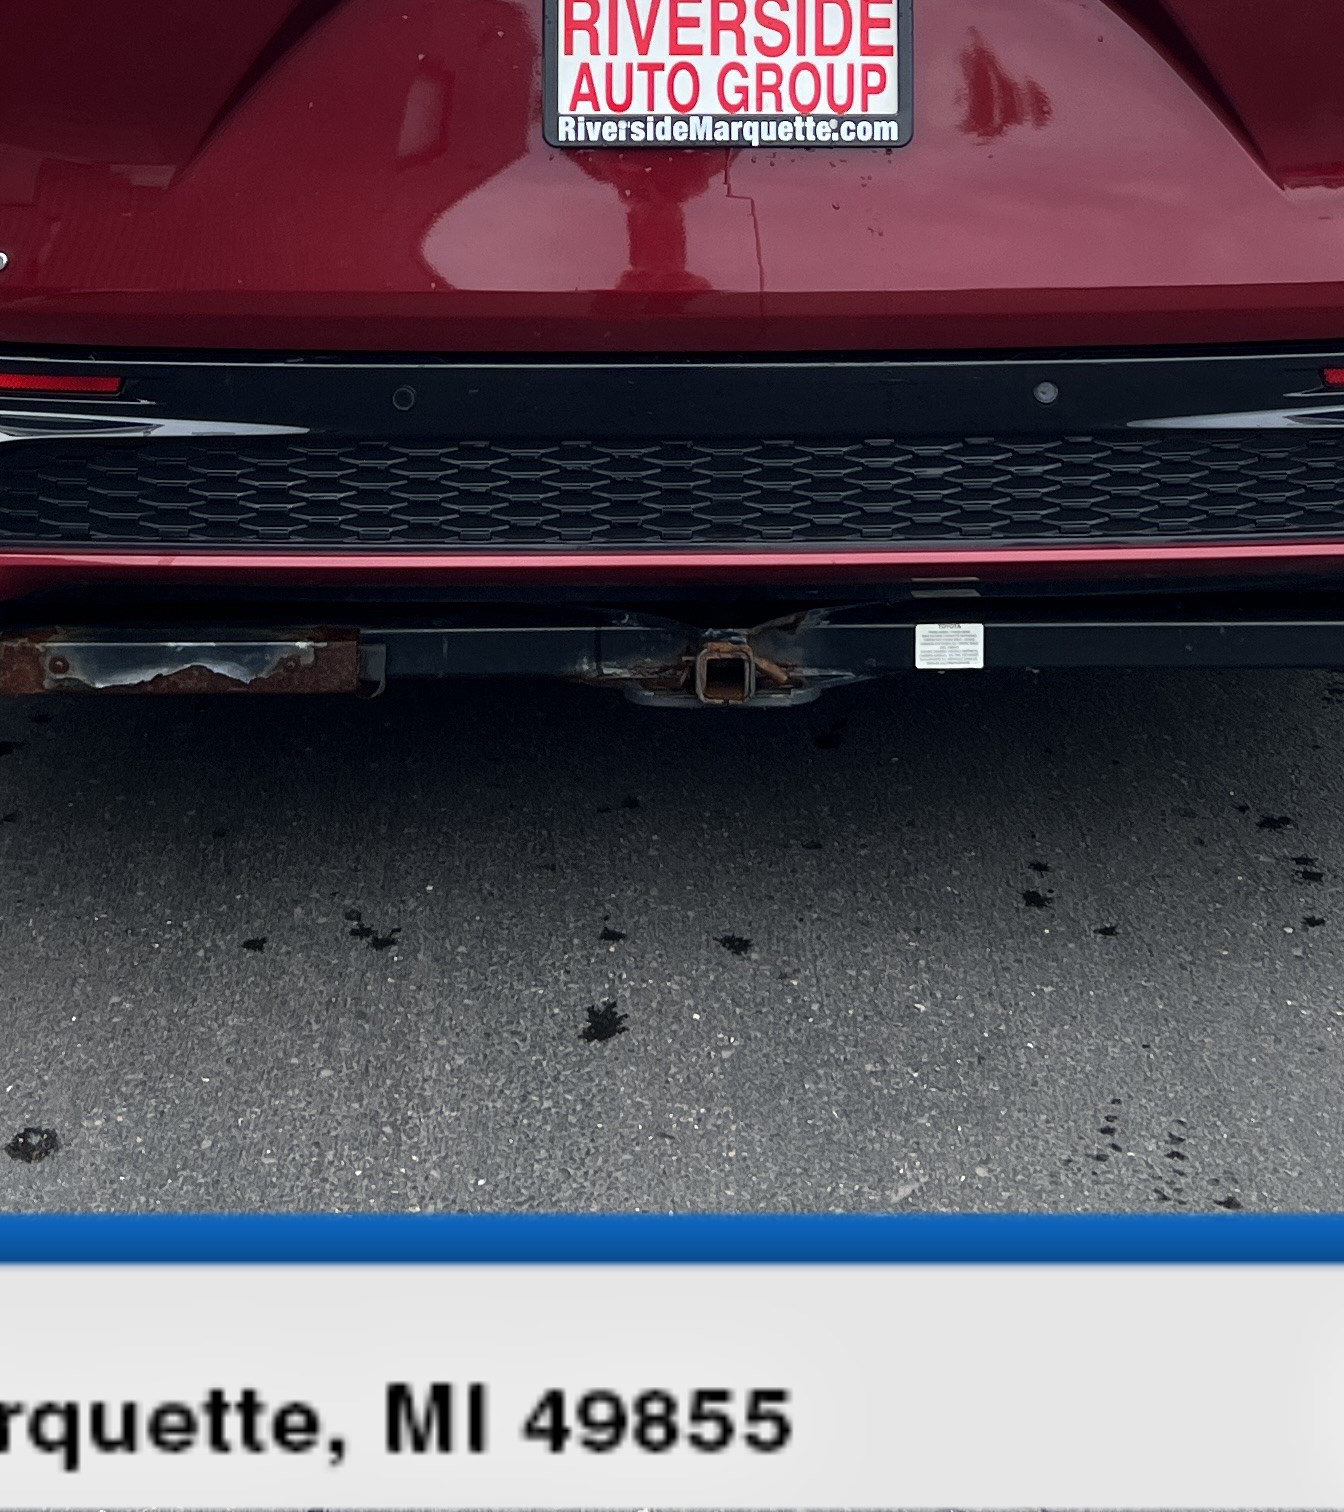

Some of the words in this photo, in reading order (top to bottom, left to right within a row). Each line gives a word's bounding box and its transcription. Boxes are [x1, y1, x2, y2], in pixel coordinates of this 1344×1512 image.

[569, 61, 700, 114] AUTO
[717, 61, 887, 114] GROUP
[558, 115, 898, 146] RiversideMarquette.com
